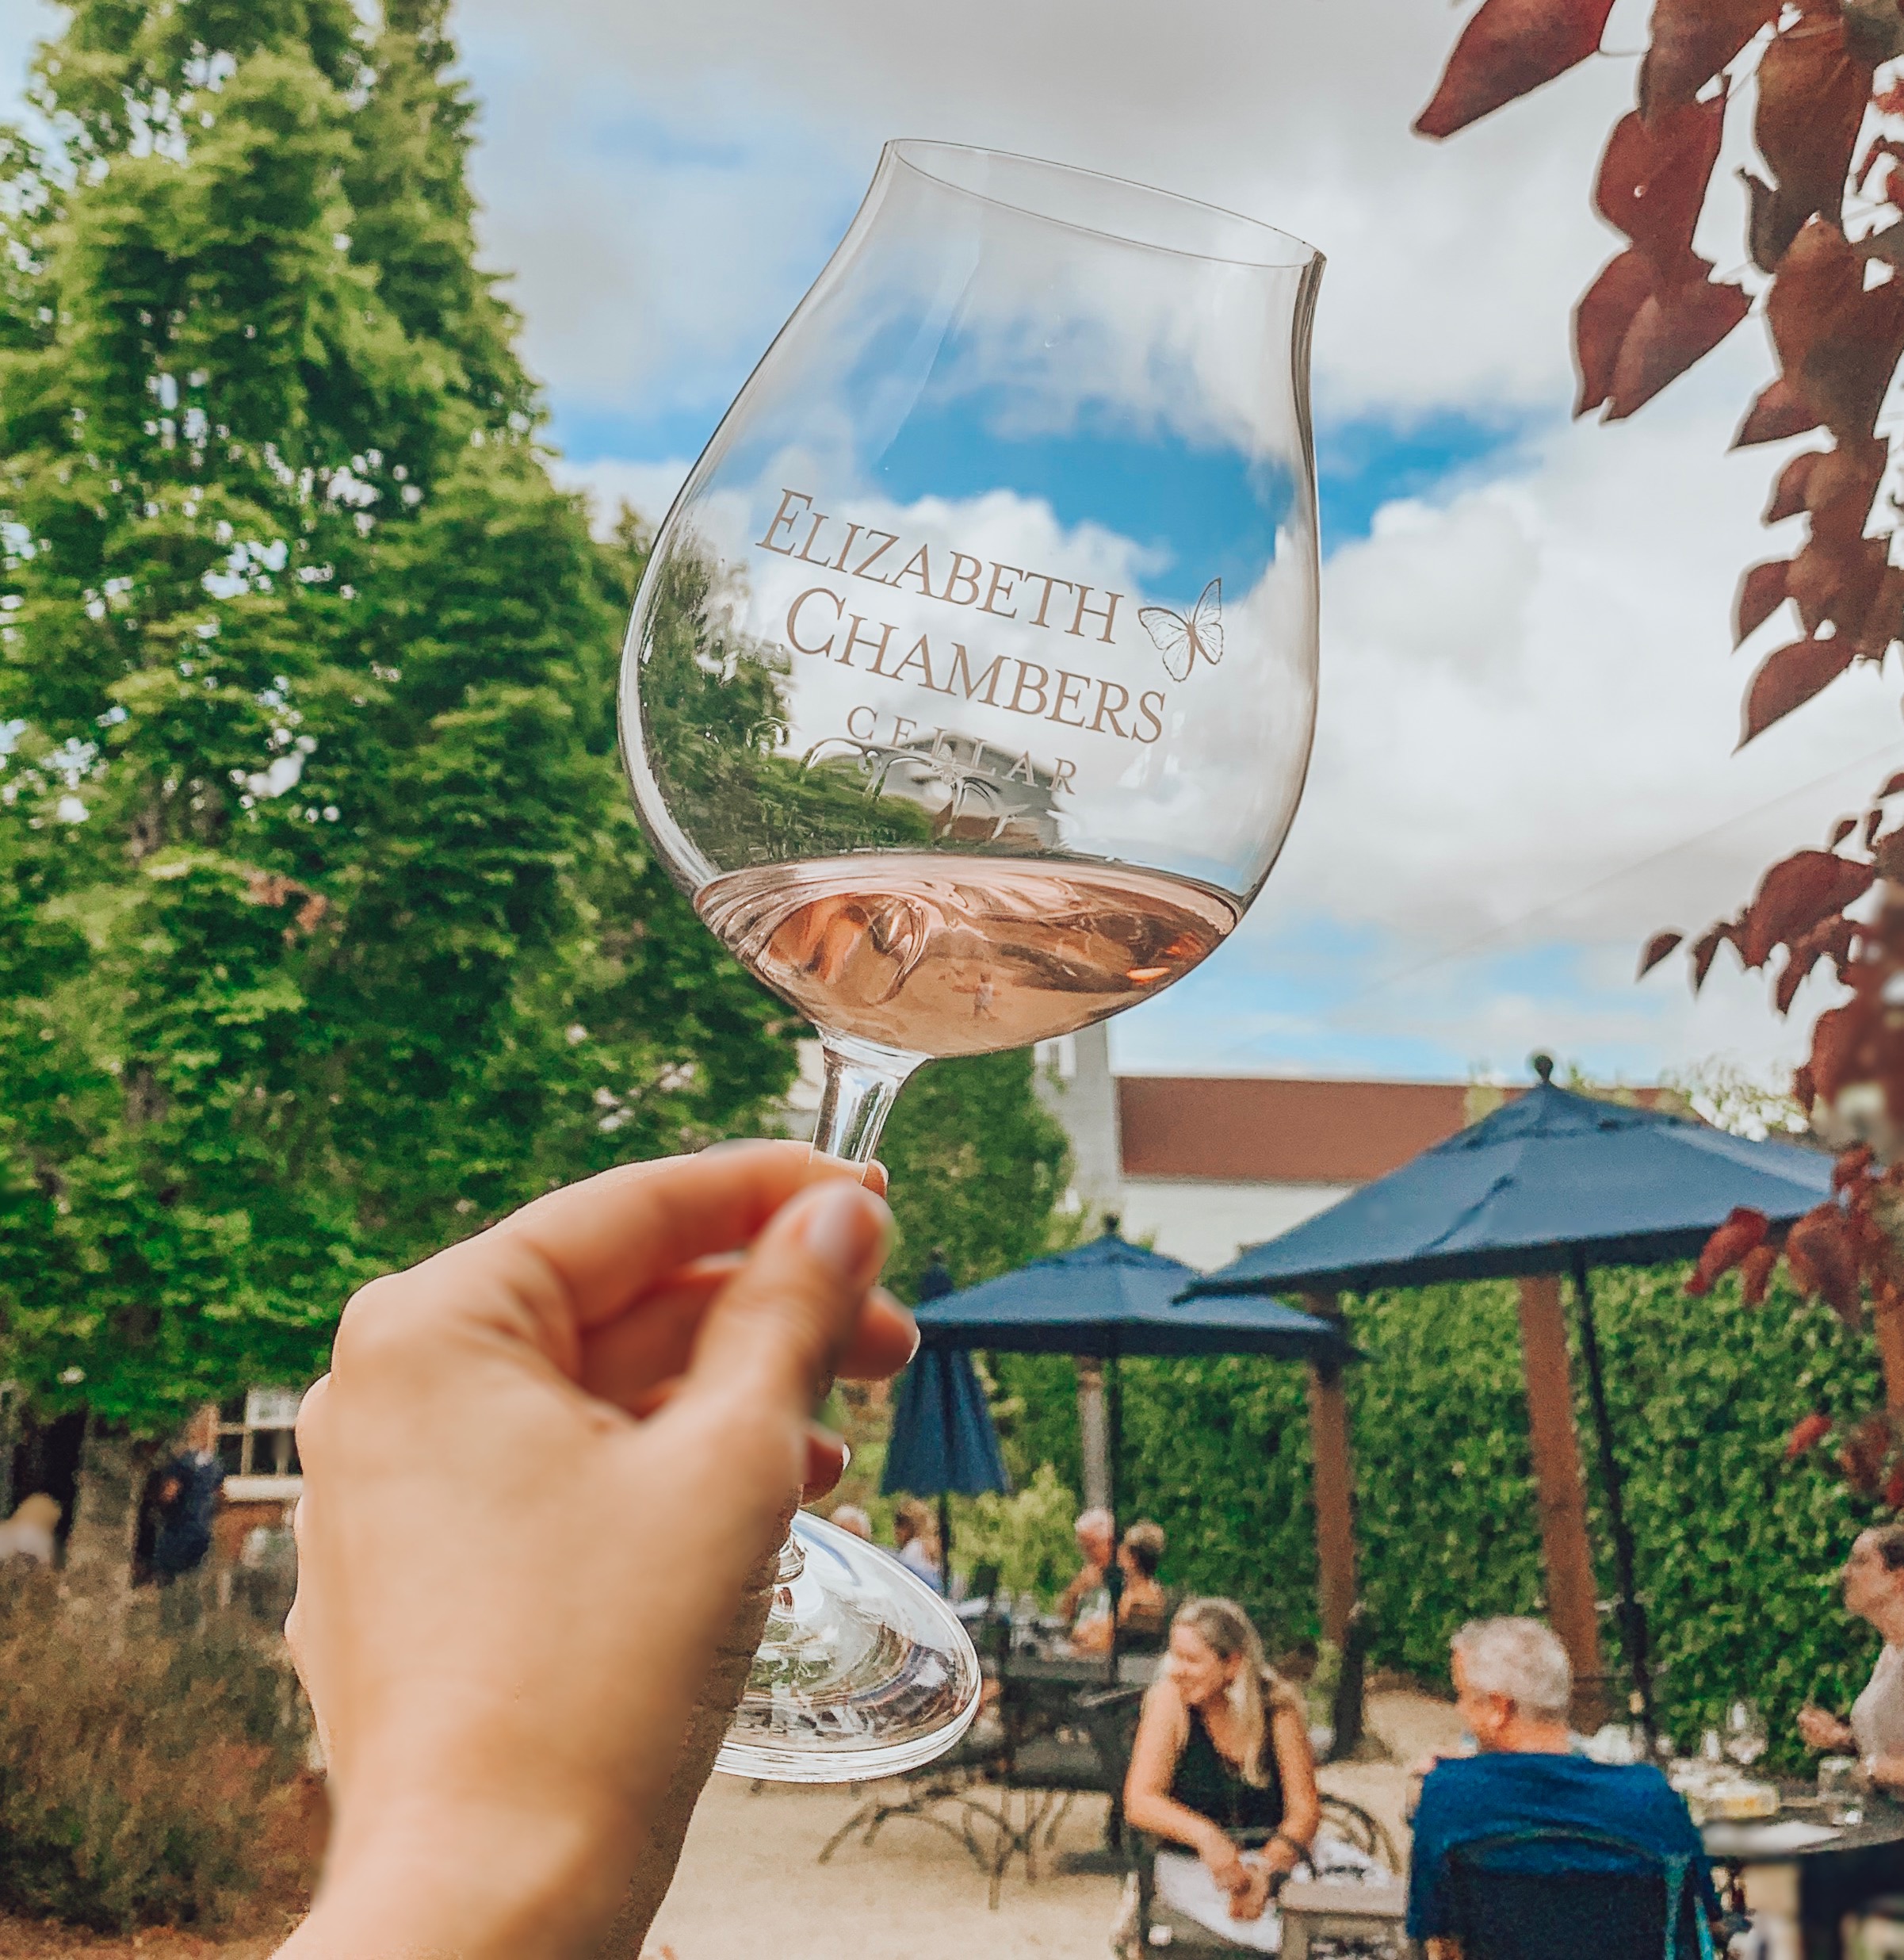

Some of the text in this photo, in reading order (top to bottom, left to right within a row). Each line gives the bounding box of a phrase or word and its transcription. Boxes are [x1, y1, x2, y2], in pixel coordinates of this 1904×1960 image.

[755, 488, 1124, 645] ELIZABETH
[786, 588, 1166, 744] CHAMBERS
[847, 706, 1076, 795] CELLAR
